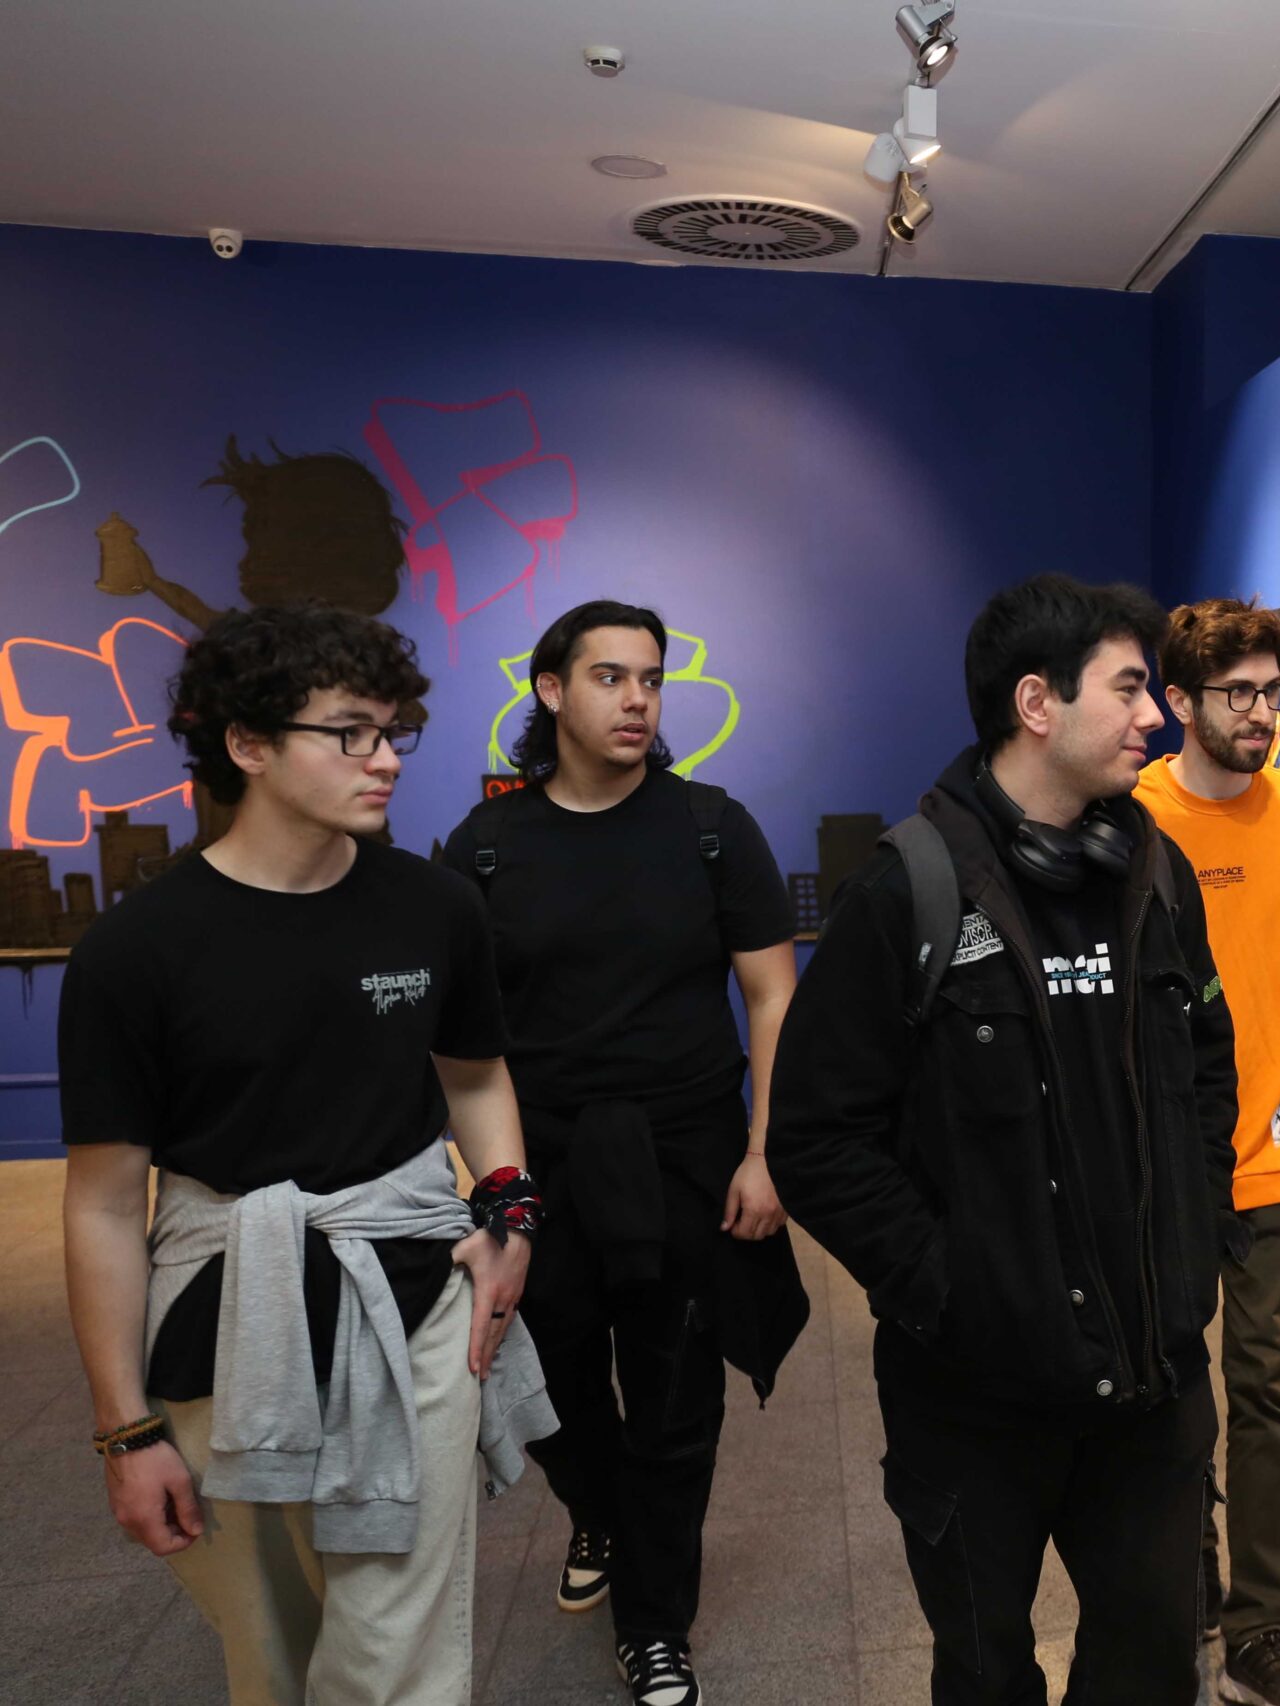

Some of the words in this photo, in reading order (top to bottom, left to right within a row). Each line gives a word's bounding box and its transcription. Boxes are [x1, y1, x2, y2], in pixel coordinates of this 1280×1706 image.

[1198, 866, 1244, 878] ANYPLACE
[976, 941, 1003, 956] CONTENT
[361, 969, 431, 991] staunch
